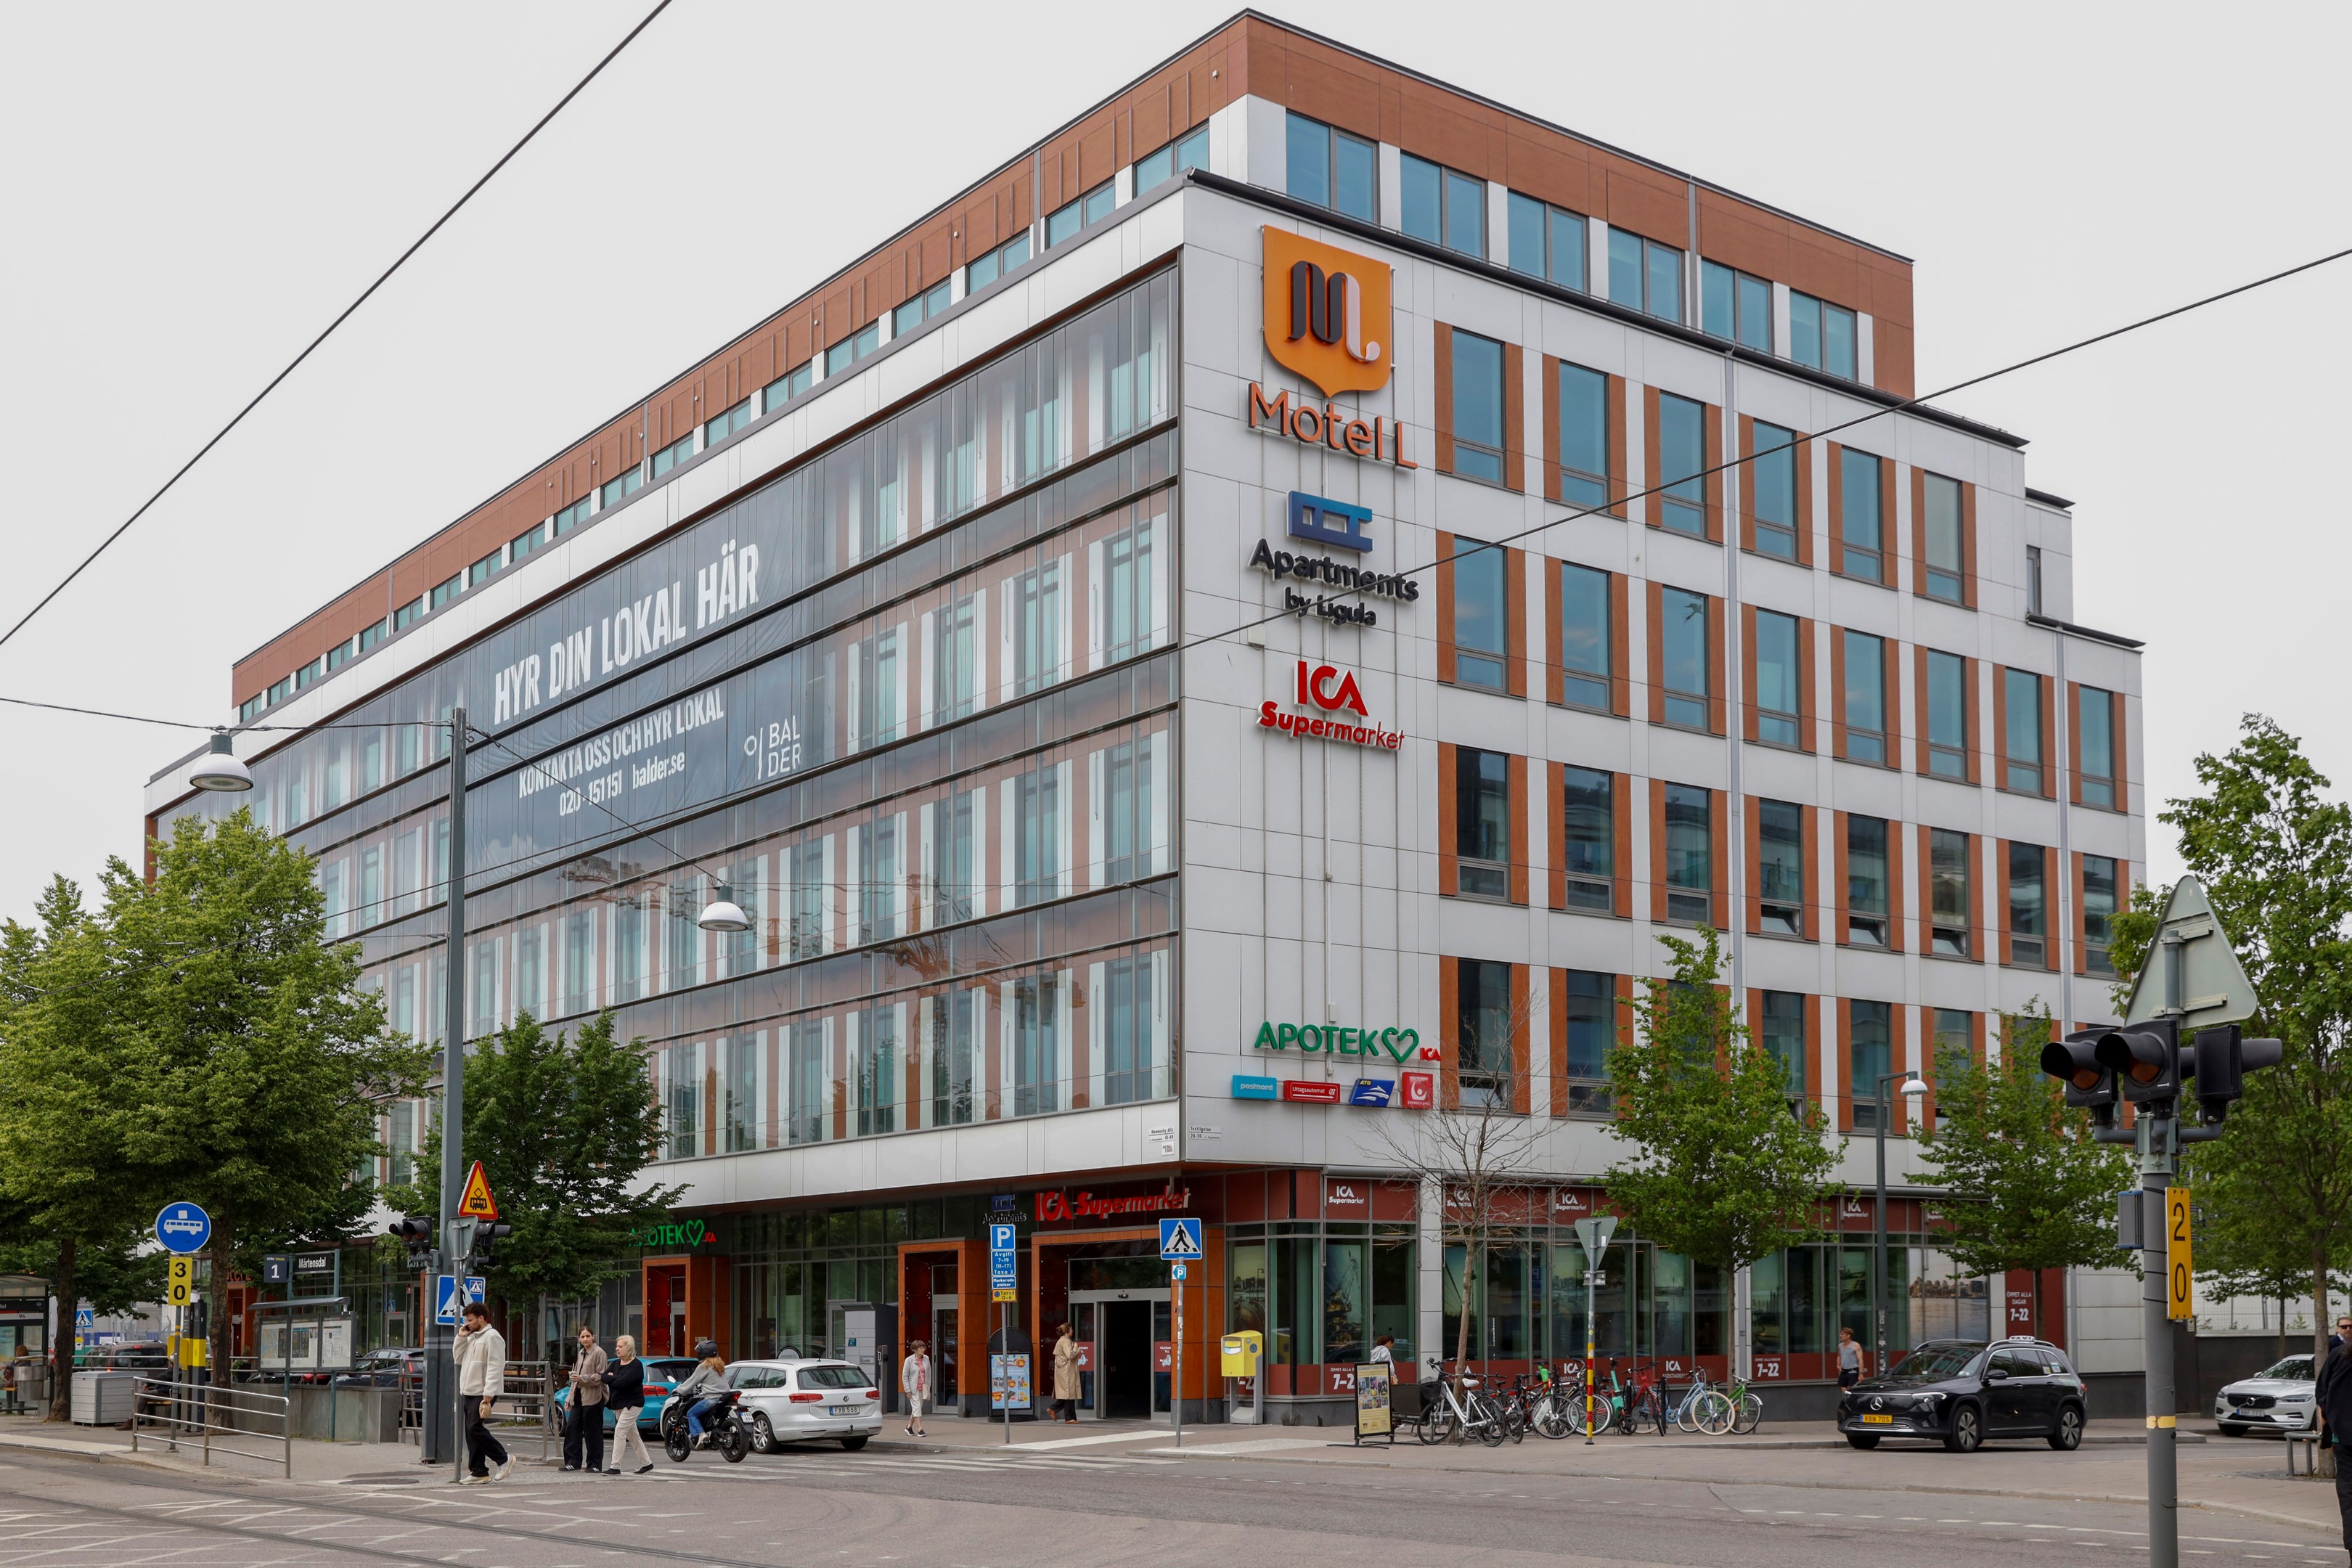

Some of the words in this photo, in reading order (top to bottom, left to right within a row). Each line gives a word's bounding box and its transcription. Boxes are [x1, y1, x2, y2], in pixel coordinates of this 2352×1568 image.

[1248, 382, 1382, 461] Motel
[1249, 539, 1419, 602] Apartments
[1284, 587, 1312, 617] by
[1316, 594, 1377, 626] Ligula
[494, 654, 540, 724] HYR
[549, 626, 592, 699] DIN
[602, 581, 686, 675] LOKAL
[697, 539, 759, 629] HÄR
[1294, 660, 1368, 716] ICA
[769, 715, 801, 749] BAL
[1256, 701, 1405, 751] Supermarket
[518, 746, 582, 799] KONTAKTA
[585, 734, 611, 772] OSS
[613, 725, 642, 757] OCH
[643, 709, 671, 749] HYR
[676, 687, 724, 735] LOKAL
[632, 752, 685, 790] balder.se
[767, 743, 801, 777] DER
[1254, 1021, 1379, 1056] APOTEK
[1420, 1048, 1441, 1061] ICA
[1035, 1191, 1073, 1222] ICA
[1075, 1185, 1190, 1220] Supermarket
[1336, 1185, 1355, 1198] ICA
[1561, 1193, 1578, 1205] ICA
[1847, 1202, 1861, 1212] ICA
[705, 1232, 716, 1243] ICA
[997, 1227, 1010, 1248] P
[271, 1264, 279, 1278] 1
[298, 1257, 326, 1268] Mårtensdal
[2010, 1308, 2029, 1321] 7-22
[1564, 1363, 1579, 1374] ICA
[1665, 1360, 1681, 1371] ICA
[1757, 1363, 1779, 1377] 7-22
[1333, 1373, 1355, 1389] 7-2
